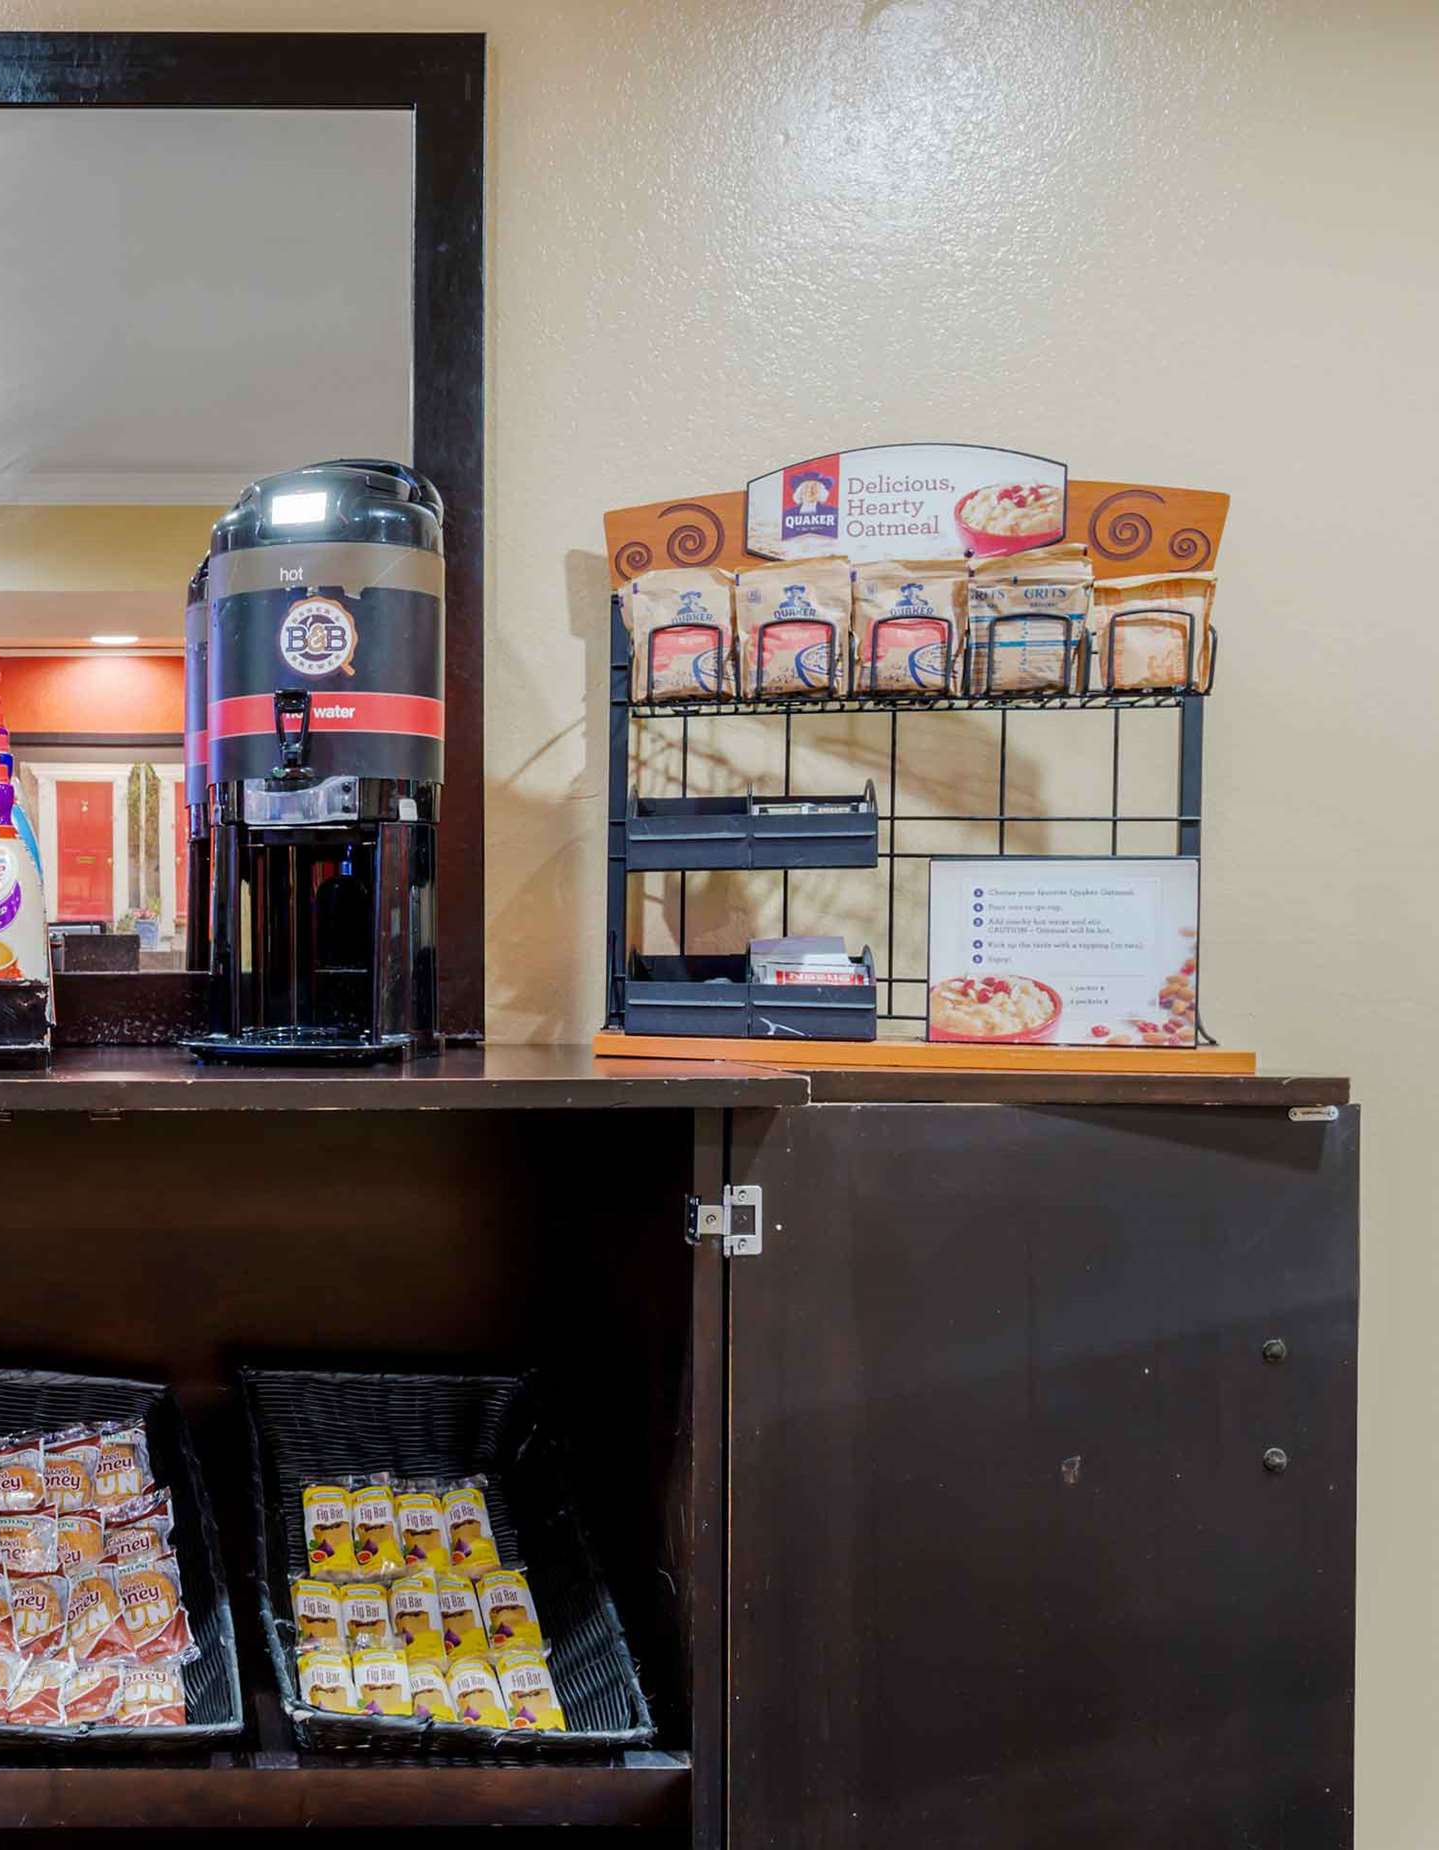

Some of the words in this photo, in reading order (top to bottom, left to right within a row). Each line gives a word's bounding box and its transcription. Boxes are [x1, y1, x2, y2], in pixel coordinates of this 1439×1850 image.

[847, 475, 956, 495] Delicious,
[847, 498, 923, 518] Hearty
[785, 514, 835, 528] QUAKER
[846, 515, 940, 538] Oatmeal
[279, 567, 303, 582] hot
[1023, 586, 1067, 600] GRITS
[774, 607, 817, 619] QUAKER
[889, 606, 934, 617] QUAKER
[285, 624, 347, 652] B&B
[313, 705, 356, 719] water
[96, 1469, 141, 1495] UN
[316, 1508, 329, 1520] Fig
[329, 1507, 344, 1519] Bar
[360, 1507, 373, 1521] Fig
[373, 1506, 387, 1518] Bar
[460, 1504, 476, 1518] Bar
[406, 1513, 419, 1528] Fig
[419, 1513, 433, 1526] Bar
[14, 1595, 47, 1611] ney
[395, 1597, 408, 1609] Fig
[408, 1595, 423, 1608] Bar
[451, 1594, 466, 1608] Bar
[490, 1591, 503, 1605] Fig
[503, 1589, 518, 1602] Bar
[303, 1599, 316, 1615] Fig
[316, 1600, 331, 1614] Bar
[351, 1604, 365, 1619] Fig
[365, 1604, 380, 1617] Bar
[69, 1600, 111, 1640] UN
[122, 1599, 172, 1633] UN
[380, 1667, 396, 1681] Bar
[511, 1672, 526, 1689] Fig
[525, 1670, 542, 1685] Bar
[124, 1683, 173, 1701] UN
